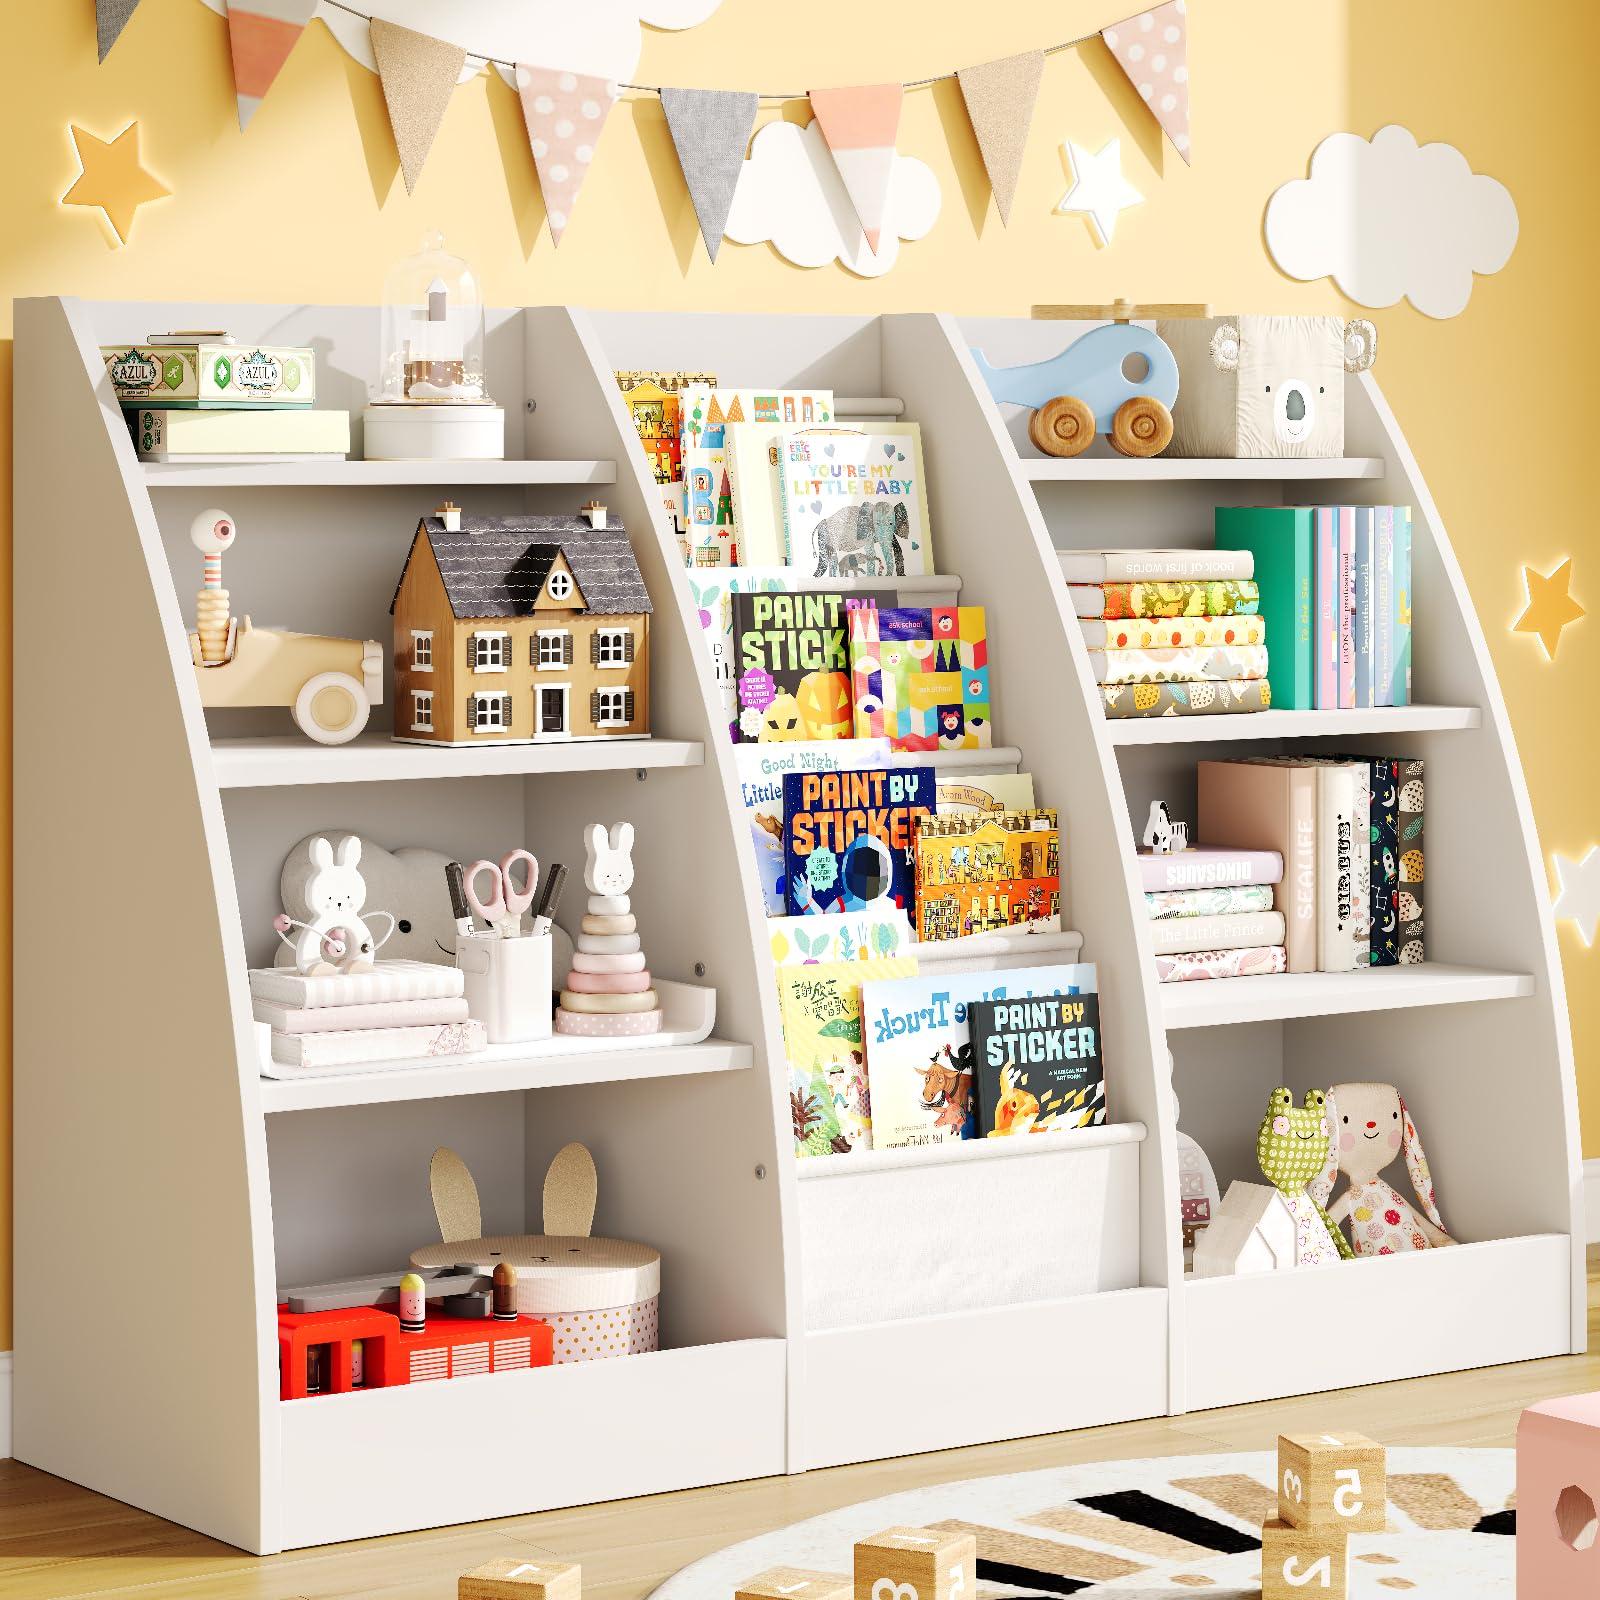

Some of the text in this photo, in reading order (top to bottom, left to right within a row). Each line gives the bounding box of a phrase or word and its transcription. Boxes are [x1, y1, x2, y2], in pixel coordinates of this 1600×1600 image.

[120, 366, 148, 379] AZUL
[246, 366, 270, 379] AZUL
[808, 464, 894, 478] YOU'RE MY
[794, 480, 913, 495] LITTLE BABY
[1126, 562, 1235, 576] book of first words
[753, 595, 842, 629] PAINT
[1361, 563, 1369, 654] Beautiful world
[888, 621, 923, 629] ask school
[742, 629, 847, 670] STICK
[761, 753, 795, 774] Good
[741, 783, 782, 807] Little
[803, 772, 919, 810] PAINT BY
[1166, 861, 1251, 885] DINOSAURS
[1338, 821, 1350, 921] CIRCUS
[1161, 923, 1265, 942] The Little Prince
[994, 1001, 1060, 1032] PAINT
[1061, 1003, 1085, 1024] BY
[986, 1026, 1098, 1067] STICKER
